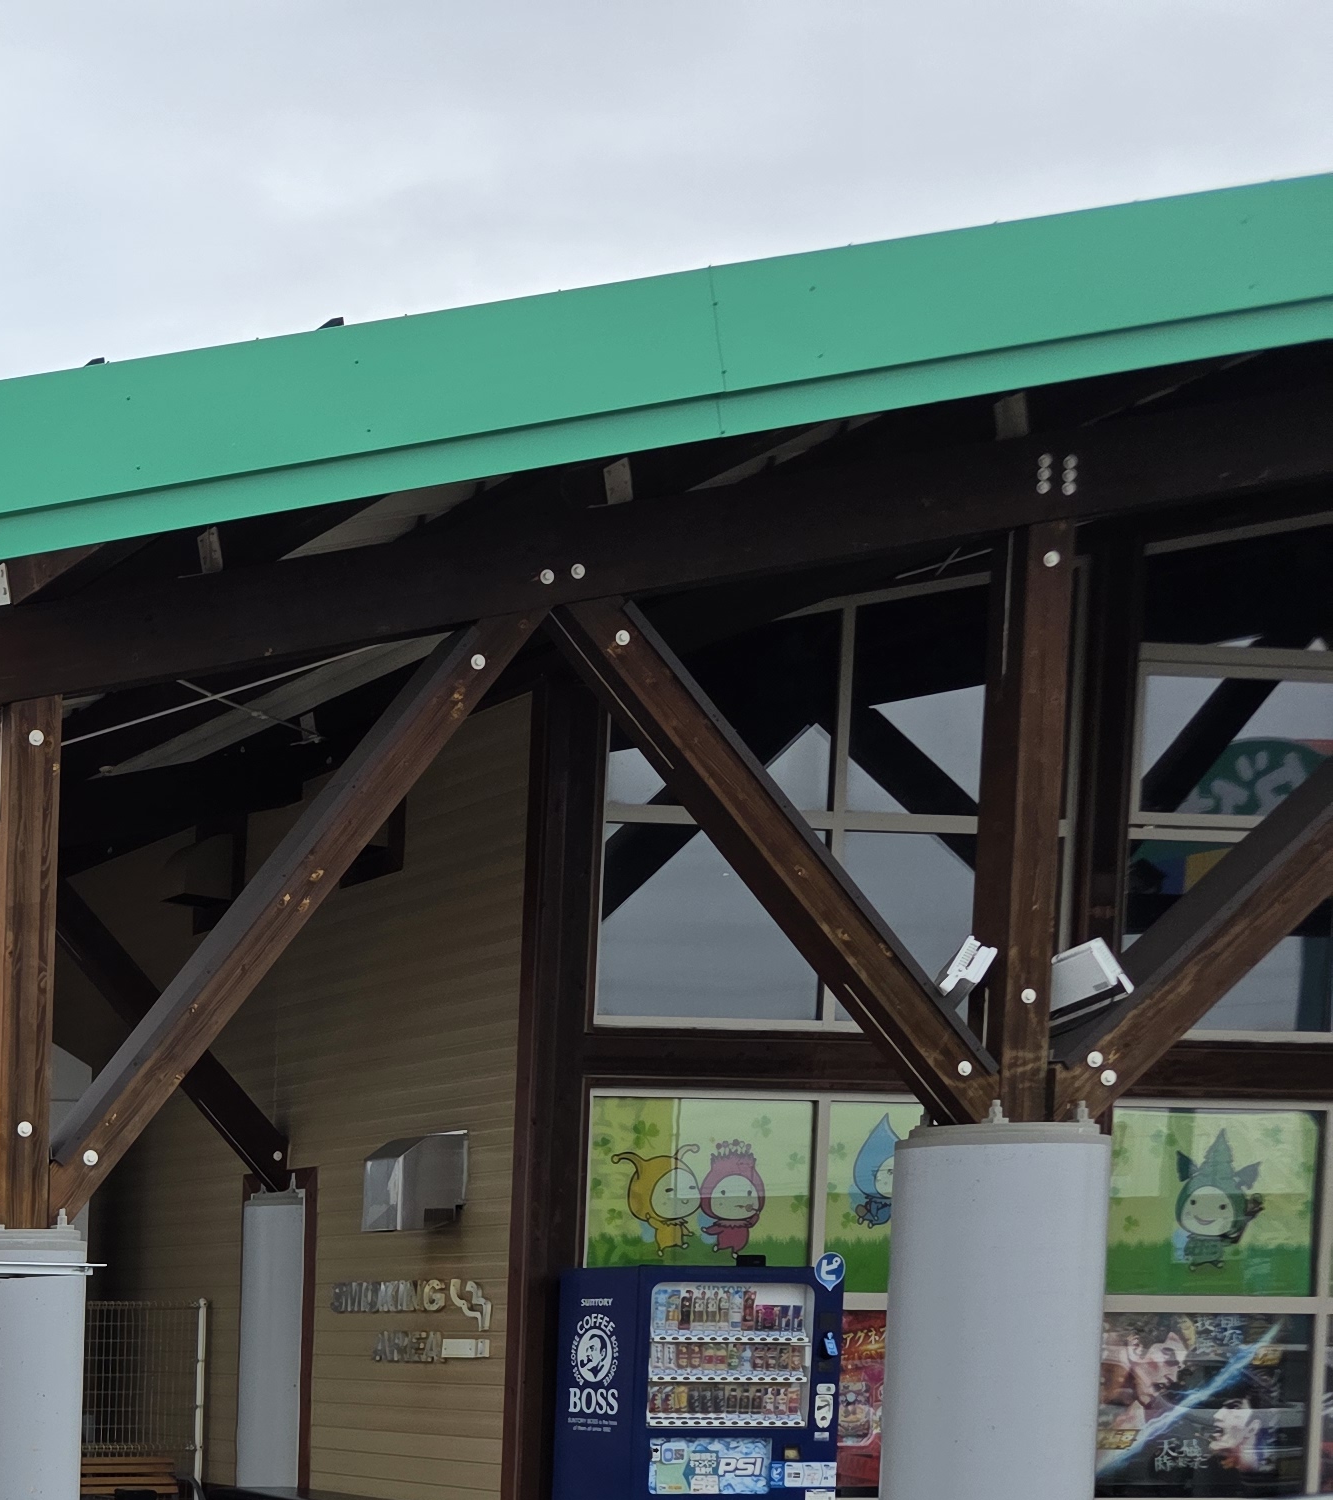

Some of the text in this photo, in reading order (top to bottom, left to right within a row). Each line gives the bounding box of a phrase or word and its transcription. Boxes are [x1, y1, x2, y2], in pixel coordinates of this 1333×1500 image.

[821, 1257, 841, 1280] ピ
[331, 1279, 445, 1314] SMOKING
[581, 1298, 613, 1306] SUNTORY
[576, 1313, 616, 1335] COFFEE
[373, 1331, 446, 1363] AREA
[568, 1388, 619, 1415] BOSS
